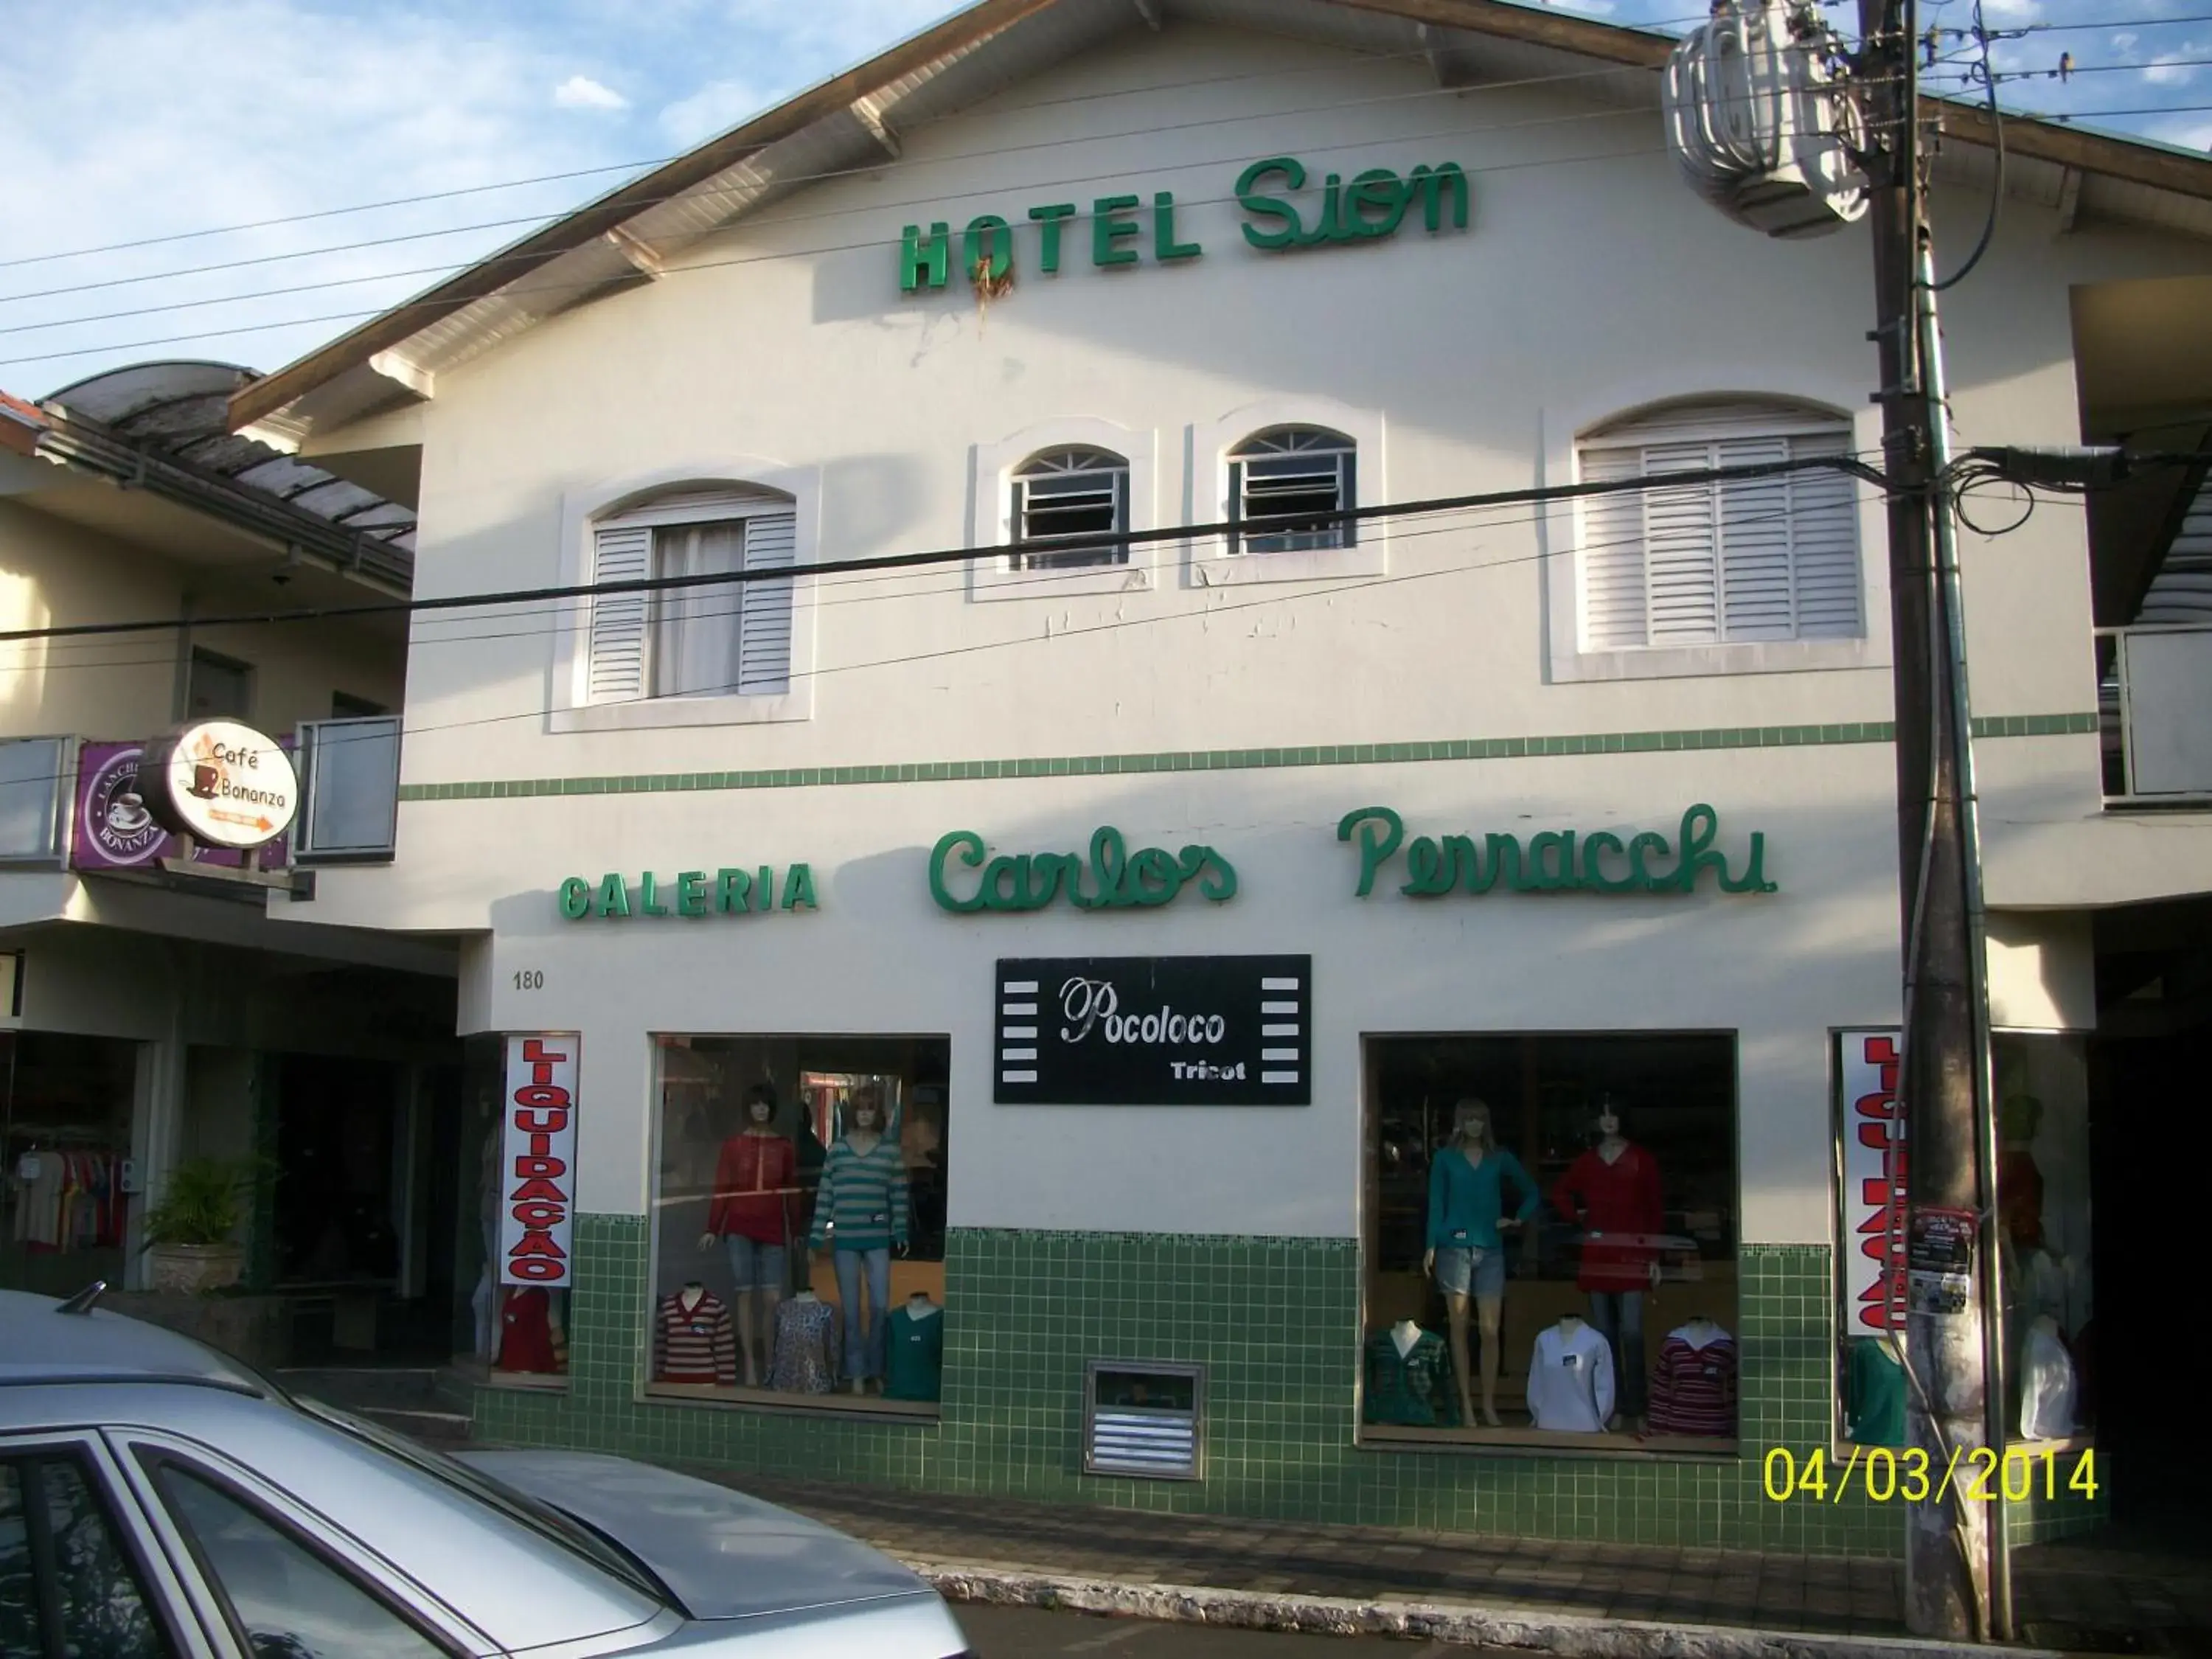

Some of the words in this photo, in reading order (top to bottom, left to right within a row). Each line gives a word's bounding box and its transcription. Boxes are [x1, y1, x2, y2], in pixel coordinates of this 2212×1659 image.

[901, 190, 1203, 291] HOTEL
[1234, 156, 1468, 250] Sion
[212, 742, 258, 769] Café
[221, 778, 286, 809] Bonanza
[99, 824, 159, 852] BONANZA
[559, 862, 818, 920] GALERIA
[928, 825, 1237, 913] Carlos
[1337, 803, 1778, 897] Pennacchi
[512, 970, 544, 990] 180
[1058, 976, 1225, 1043] Pocoloco
[1170, 1059, 1246, 1081] Tricot
[507, 1039, 571, 1281] LIQUIDAÇÃO
